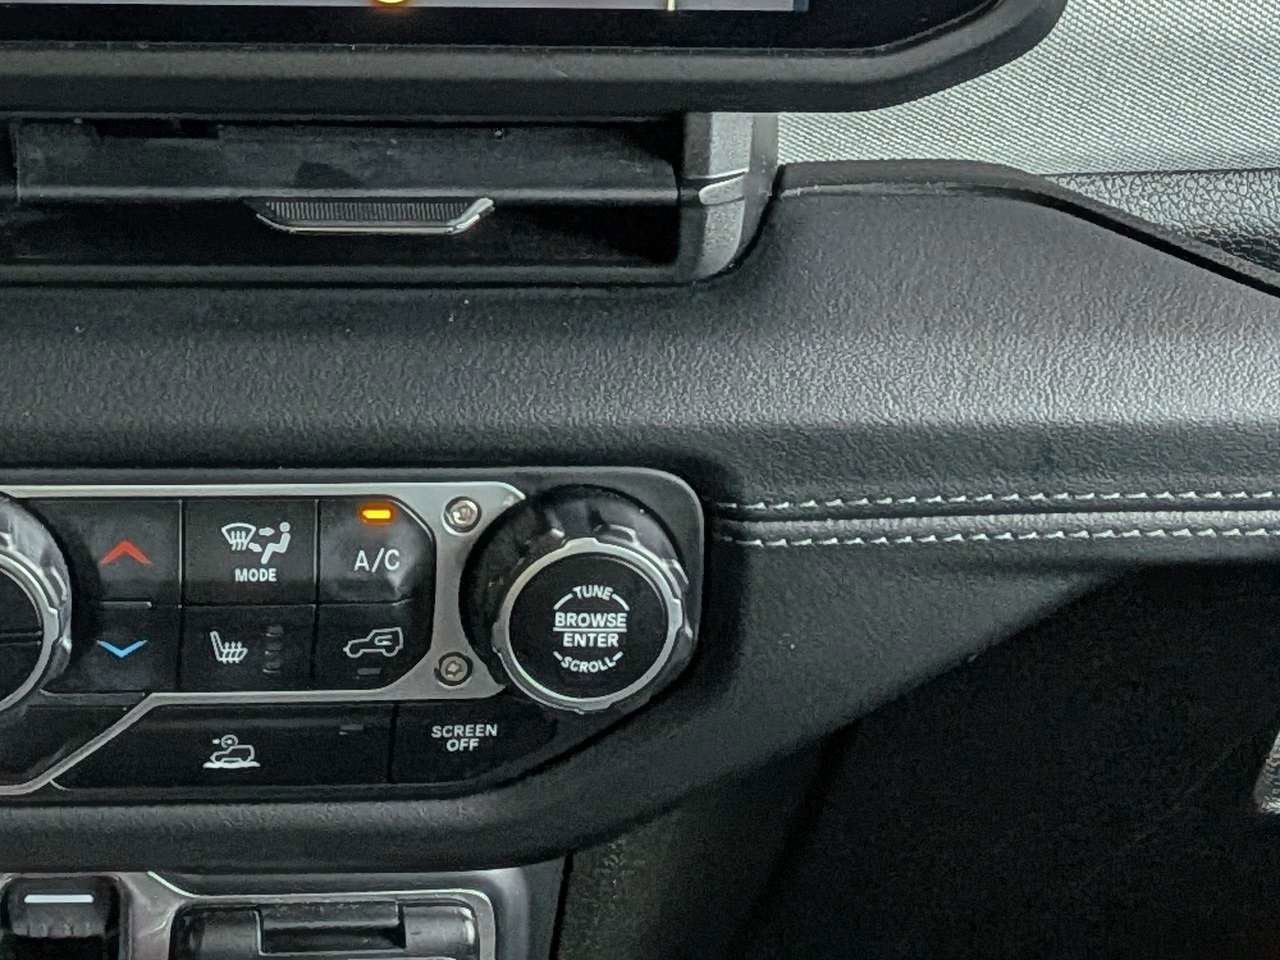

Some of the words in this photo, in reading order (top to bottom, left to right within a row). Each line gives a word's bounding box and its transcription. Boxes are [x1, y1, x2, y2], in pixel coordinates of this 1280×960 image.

[354, 548, 401, 572] A/C
[234, 567, 277, 582] MODE
[573, 585, 614, 601] TUNE
[555, 612, 628, 628] BROWSE
[563, 632, 620, 648] ENTER
[561, 654, 617, 673] SCROLL
[431, 723, 498, 738] SCREEN
[446, 738, 480, 752] OFF
